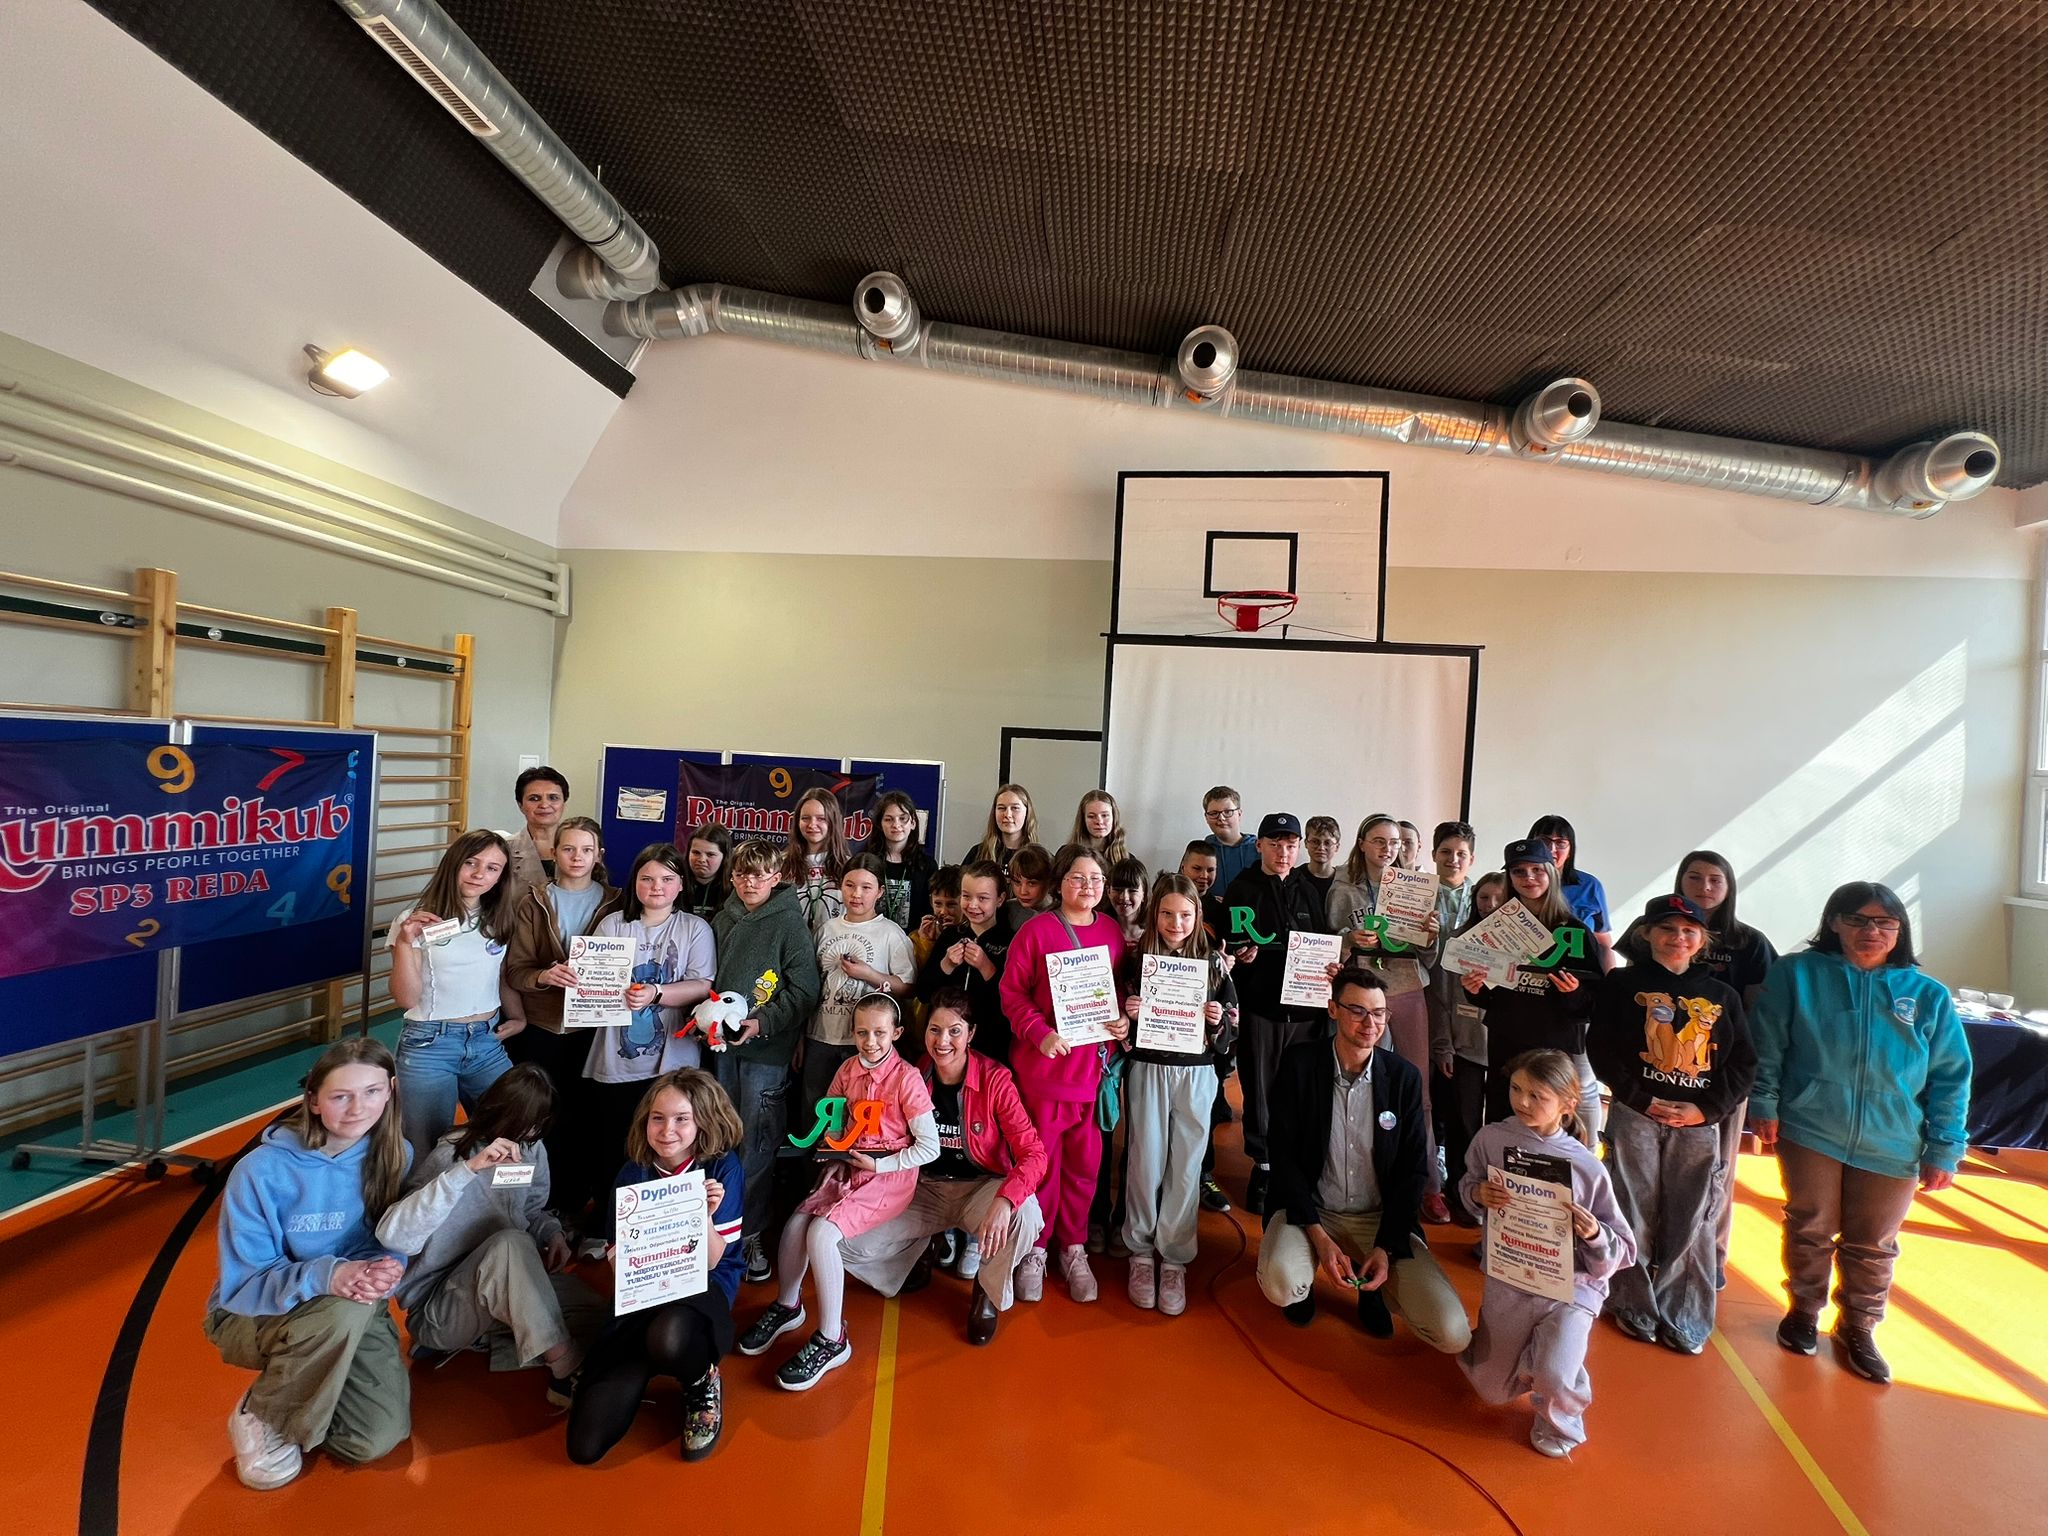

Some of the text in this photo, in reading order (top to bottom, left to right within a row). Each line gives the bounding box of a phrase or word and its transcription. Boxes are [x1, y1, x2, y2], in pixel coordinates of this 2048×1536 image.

[147, 745, 195, 794] 9
[256, 747, 305, 791] 7
[769, 767, 793, 798] 9
[4, 804, 109, 816] The Original
[0, 794, 350, 893] ummikub
[767, 834, 788, 844] PEOP
[62, 846, 300, 880] BRINGS PEOPLE TOGETHER
[1397, 872, 1430, 885] Dyplom
[69, 869, 270, 917] SP3 REDA
[266, 891, 296, 926] 4
[125, 918, 160, 948] 2
[1229, 906, 1276, 945] R
[1517, 911, 1545, 941] Dyplom
[588, 941, 625, 952] Dyplom
[852, 933, 875, 963] WEATHER
[1302, 936, 1333, 947] Dyplom
[1063, 953, 1099, 967] Dyplom
[1160, 961, 1197, 973] Dyplom
[577, 987, 620, 998] Rummikub
[1066, 998, 1109, 1014] Rummikub
[1151, 1005, 1196, 1018] Rummikub
[1643, 1067, 1711, 1089] LION KING
[641, 1181, 692, 1201] Dyplom
[1506, 1178, 1556, 1200] Dyplom
[286, 1220, 343, 1232] DENMARK
[643, 1227, 657, 1235] XIII
[659, 1219, 689, 1231] MIEJSCA
[1518, 1217, 1548, 1230] MIEJSCA
[629, 1227, 640, 1239] 13
[1500, 1232, 1560, 1258] Rummikub
[626, 1271, 661, 1285] TURNIEJU
